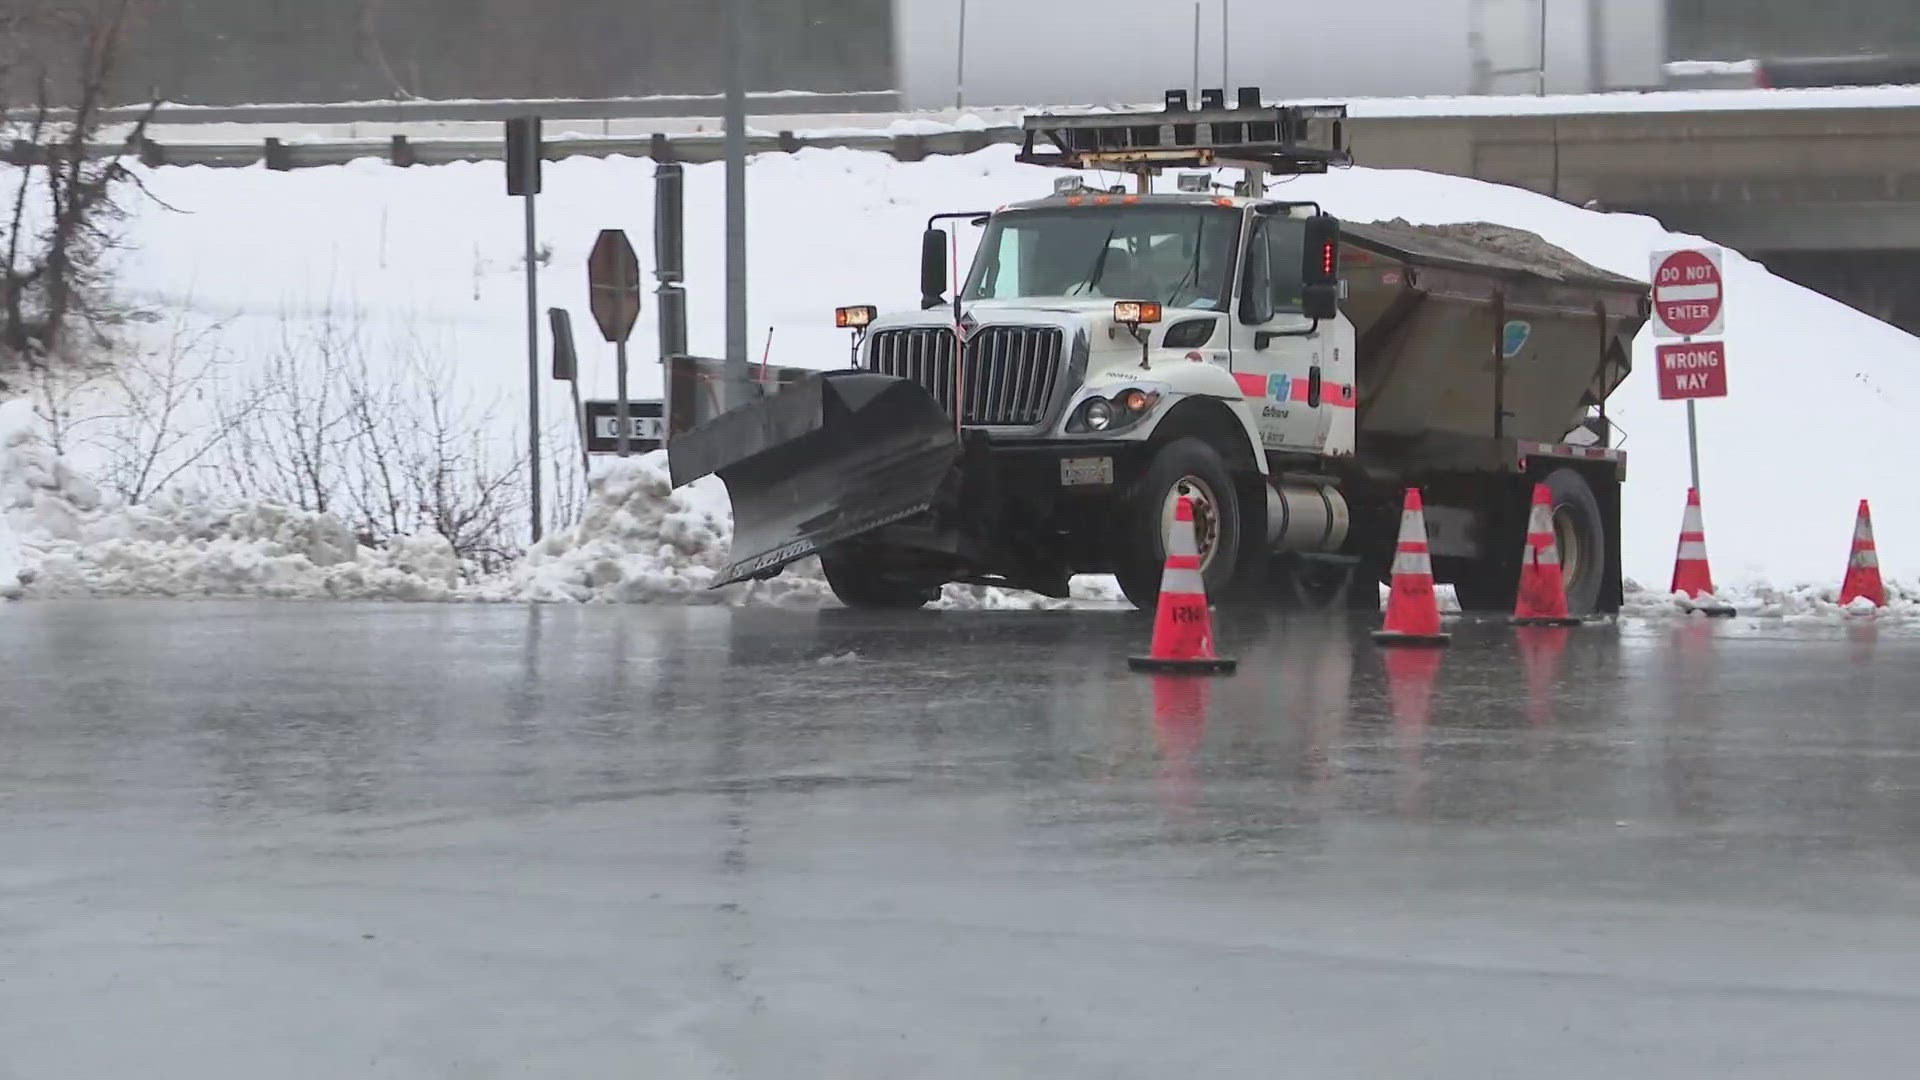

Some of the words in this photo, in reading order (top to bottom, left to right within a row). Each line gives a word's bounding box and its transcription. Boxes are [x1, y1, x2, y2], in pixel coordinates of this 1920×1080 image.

[1661, 267, 1680, 282] DO
[1686, 265, 1712, 281] NOT
[1667, 305, 1710, 320] ENTER
[1664, 351, 1718, 370] WRONG
[1676, 373, 1708, 390] WAY
[607, 418, 645, 436] OE
